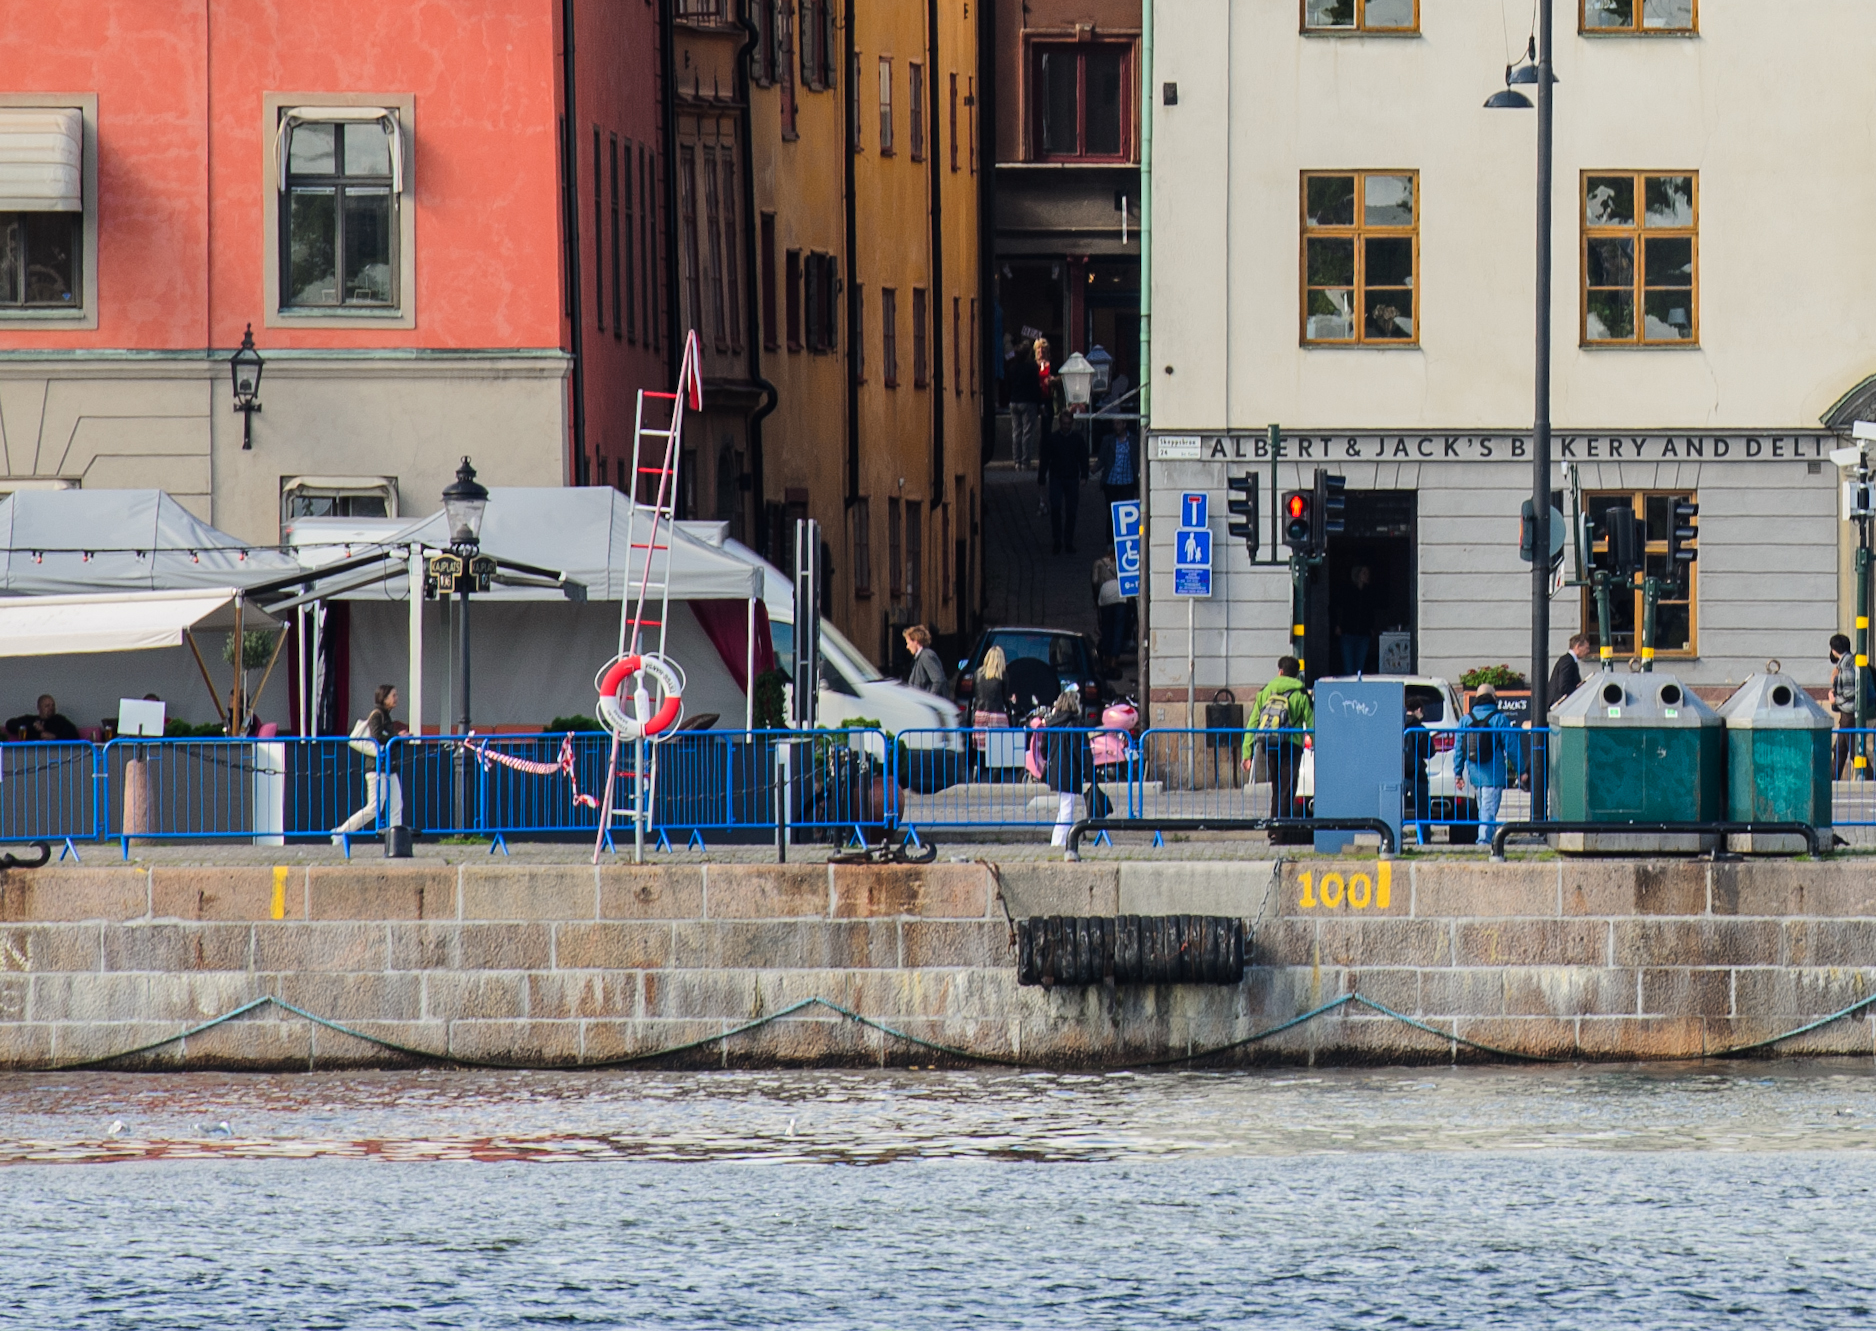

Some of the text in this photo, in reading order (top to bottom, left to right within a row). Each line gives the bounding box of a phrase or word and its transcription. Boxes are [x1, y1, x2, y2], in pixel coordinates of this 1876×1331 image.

[1210, 437, 1333, 457] ALBERT
[1345, 437, 1361, 457] &
[1511, 437, 1647, 457] BKERY
[1661, 437, 1730, 457] AND
[1745, 437, 1821, 457] DELI
[1118, 505, 1139, 536] P
